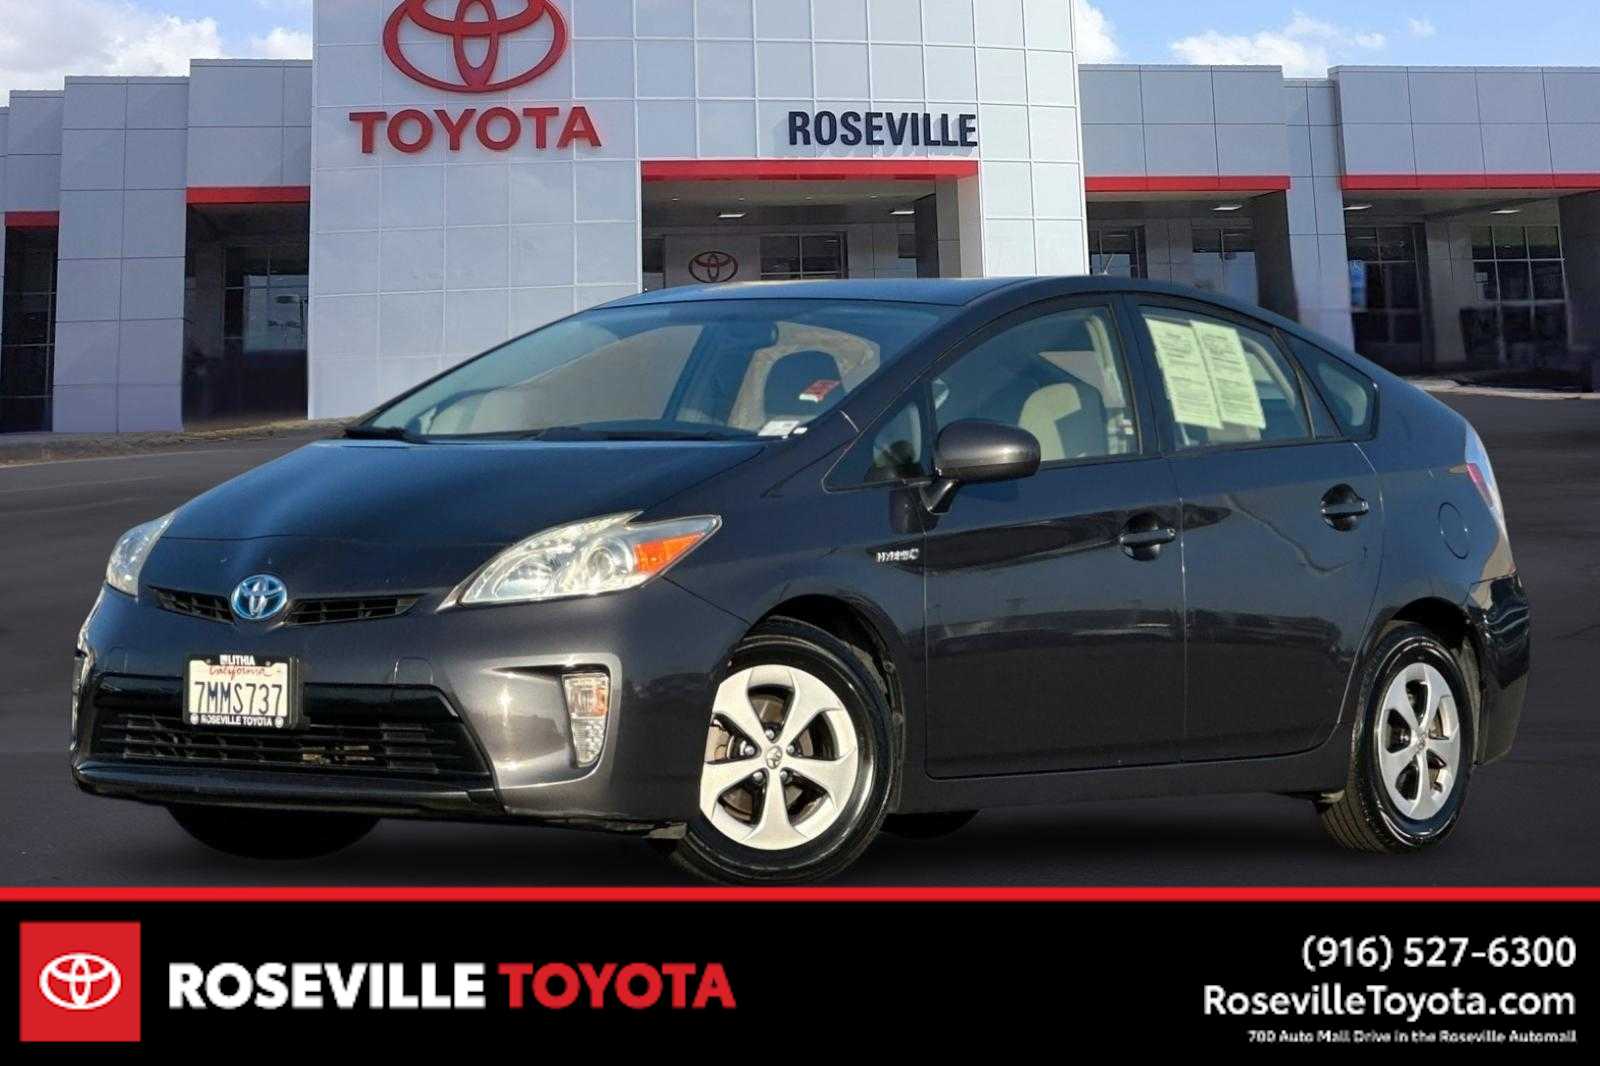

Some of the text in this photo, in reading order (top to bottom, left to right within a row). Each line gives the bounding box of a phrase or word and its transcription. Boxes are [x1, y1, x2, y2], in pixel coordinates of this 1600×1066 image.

[349, 106, 602, 154] TOYOTA
[788, 110, 978, 147] ROSEVILLE
[193, 681, 283, 717] 7MMS737
[200, 714, 273, 727] ROSEVILLE TOYOTA
